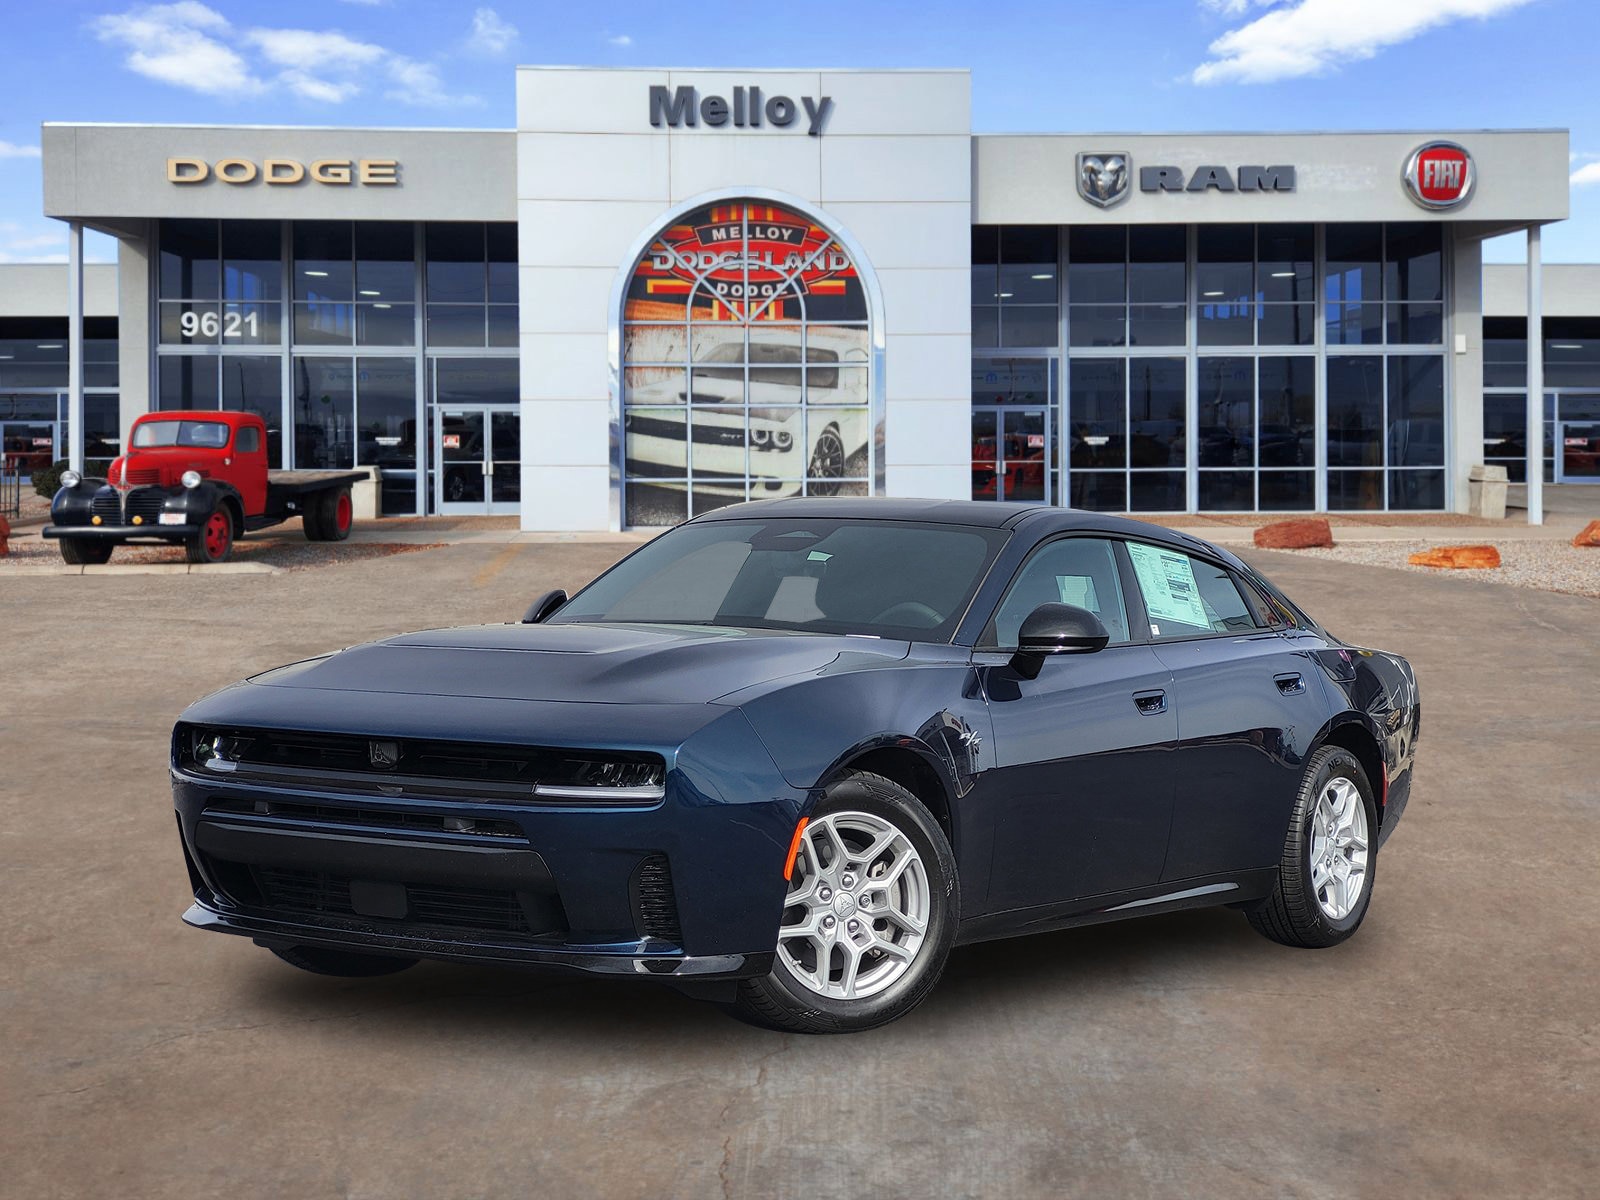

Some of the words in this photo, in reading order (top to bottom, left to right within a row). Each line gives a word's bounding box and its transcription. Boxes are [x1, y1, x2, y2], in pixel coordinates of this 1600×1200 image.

[649, 85, 832, 136] Melloy
[167, 158, 398, 184] DODGE
[1140, 165, 1296, 192] RAM
[1423, 160, 1464, 189] FIAT
[181, 311, 258, 337] 9621
